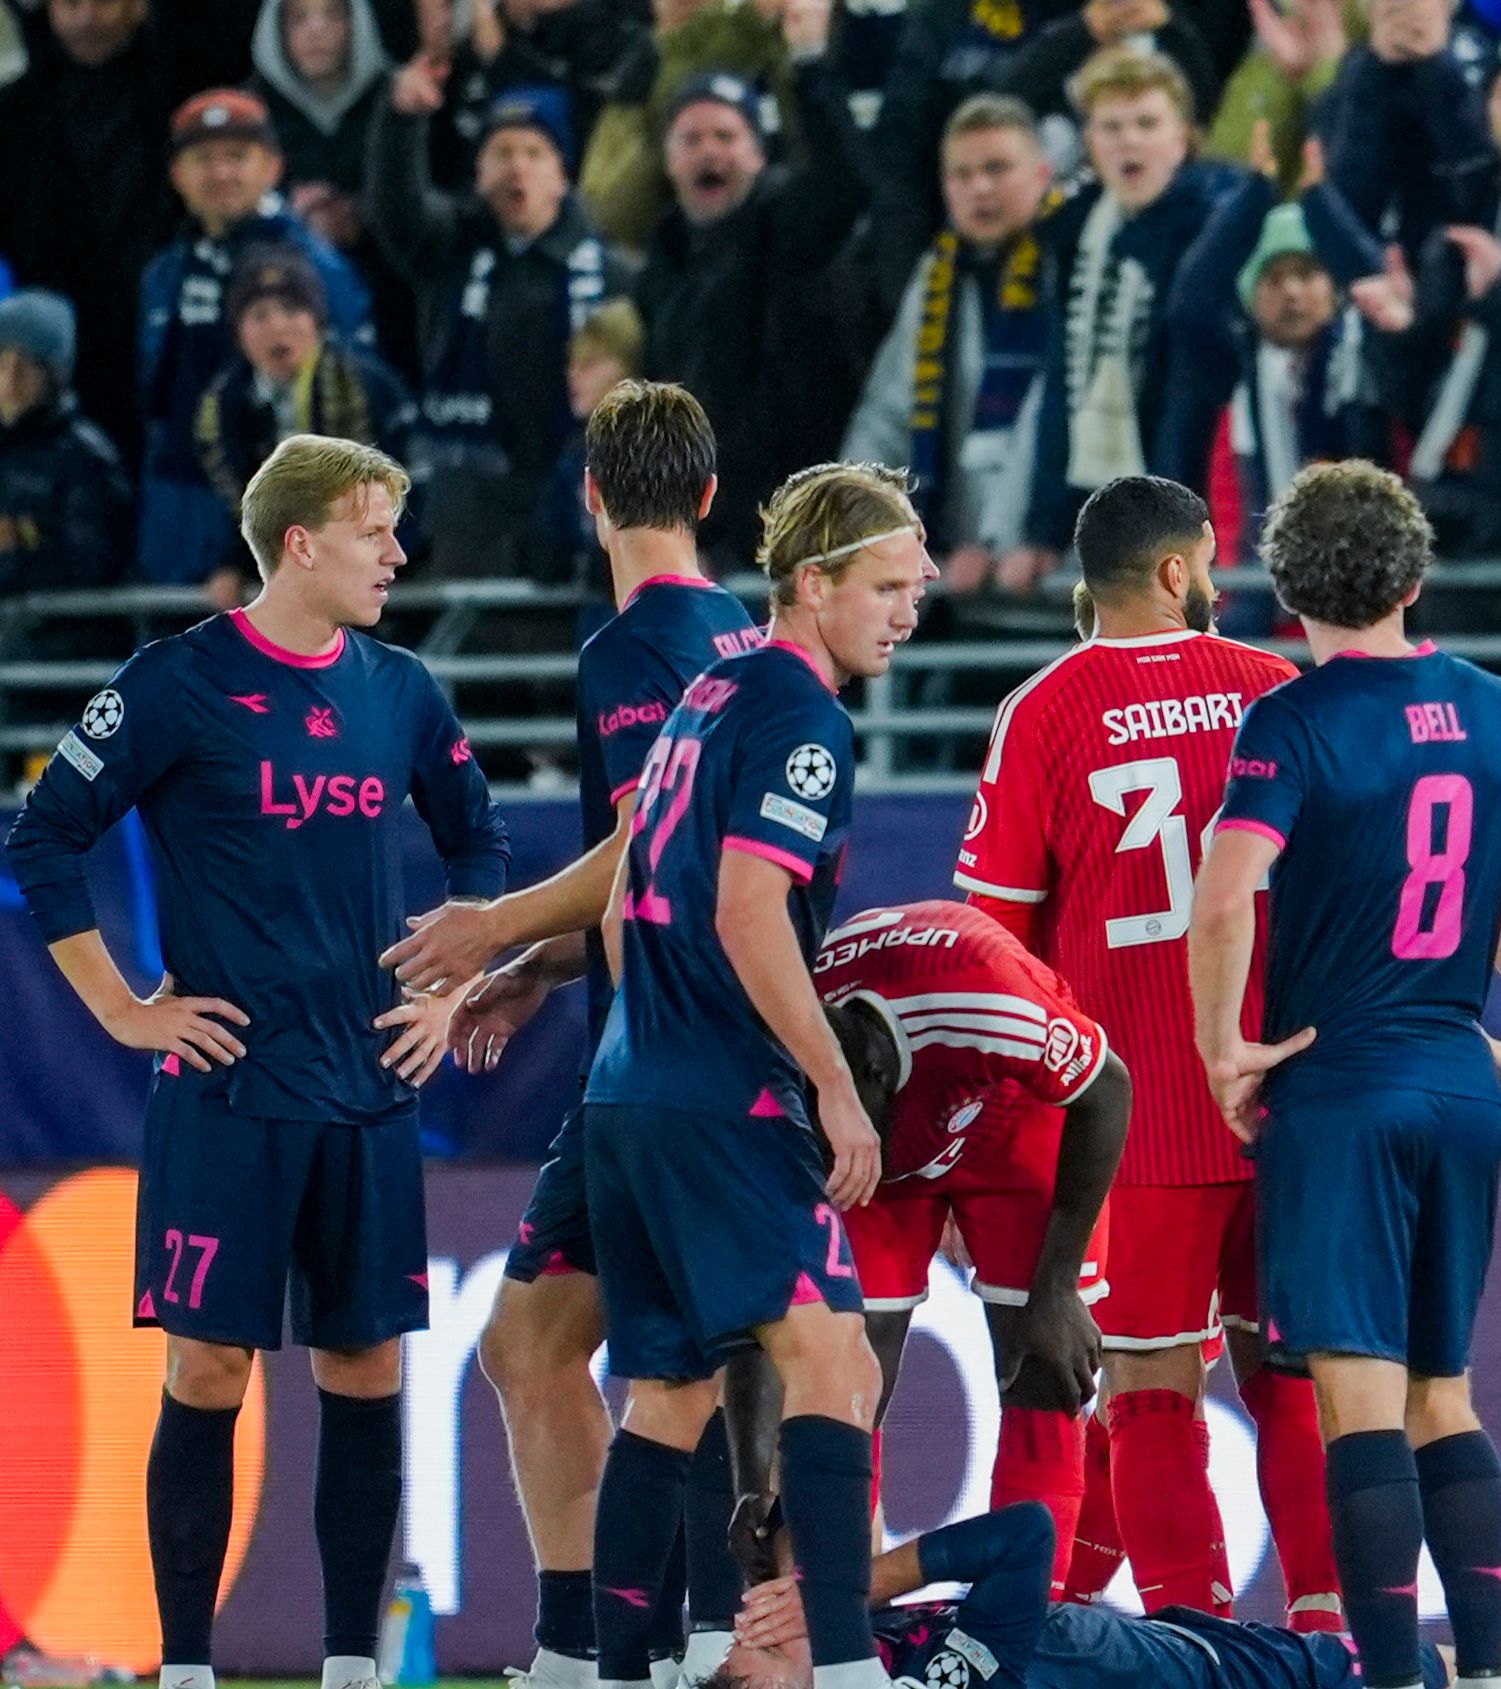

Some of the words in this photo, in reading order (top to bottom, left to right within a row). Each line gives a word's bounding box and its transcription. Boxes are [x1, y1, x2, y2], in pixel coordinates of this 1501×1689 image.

[1103, 693, 1242, 745] SAIBARI
[1405, 702, 1467, 743] BELL
[260, 760, 385, 829] Lyse
[1392, 773, 1473, 959] 8
[1060, 1034, 1093, 1086] Allianz
[164, 1228, 219, 1309] 27
